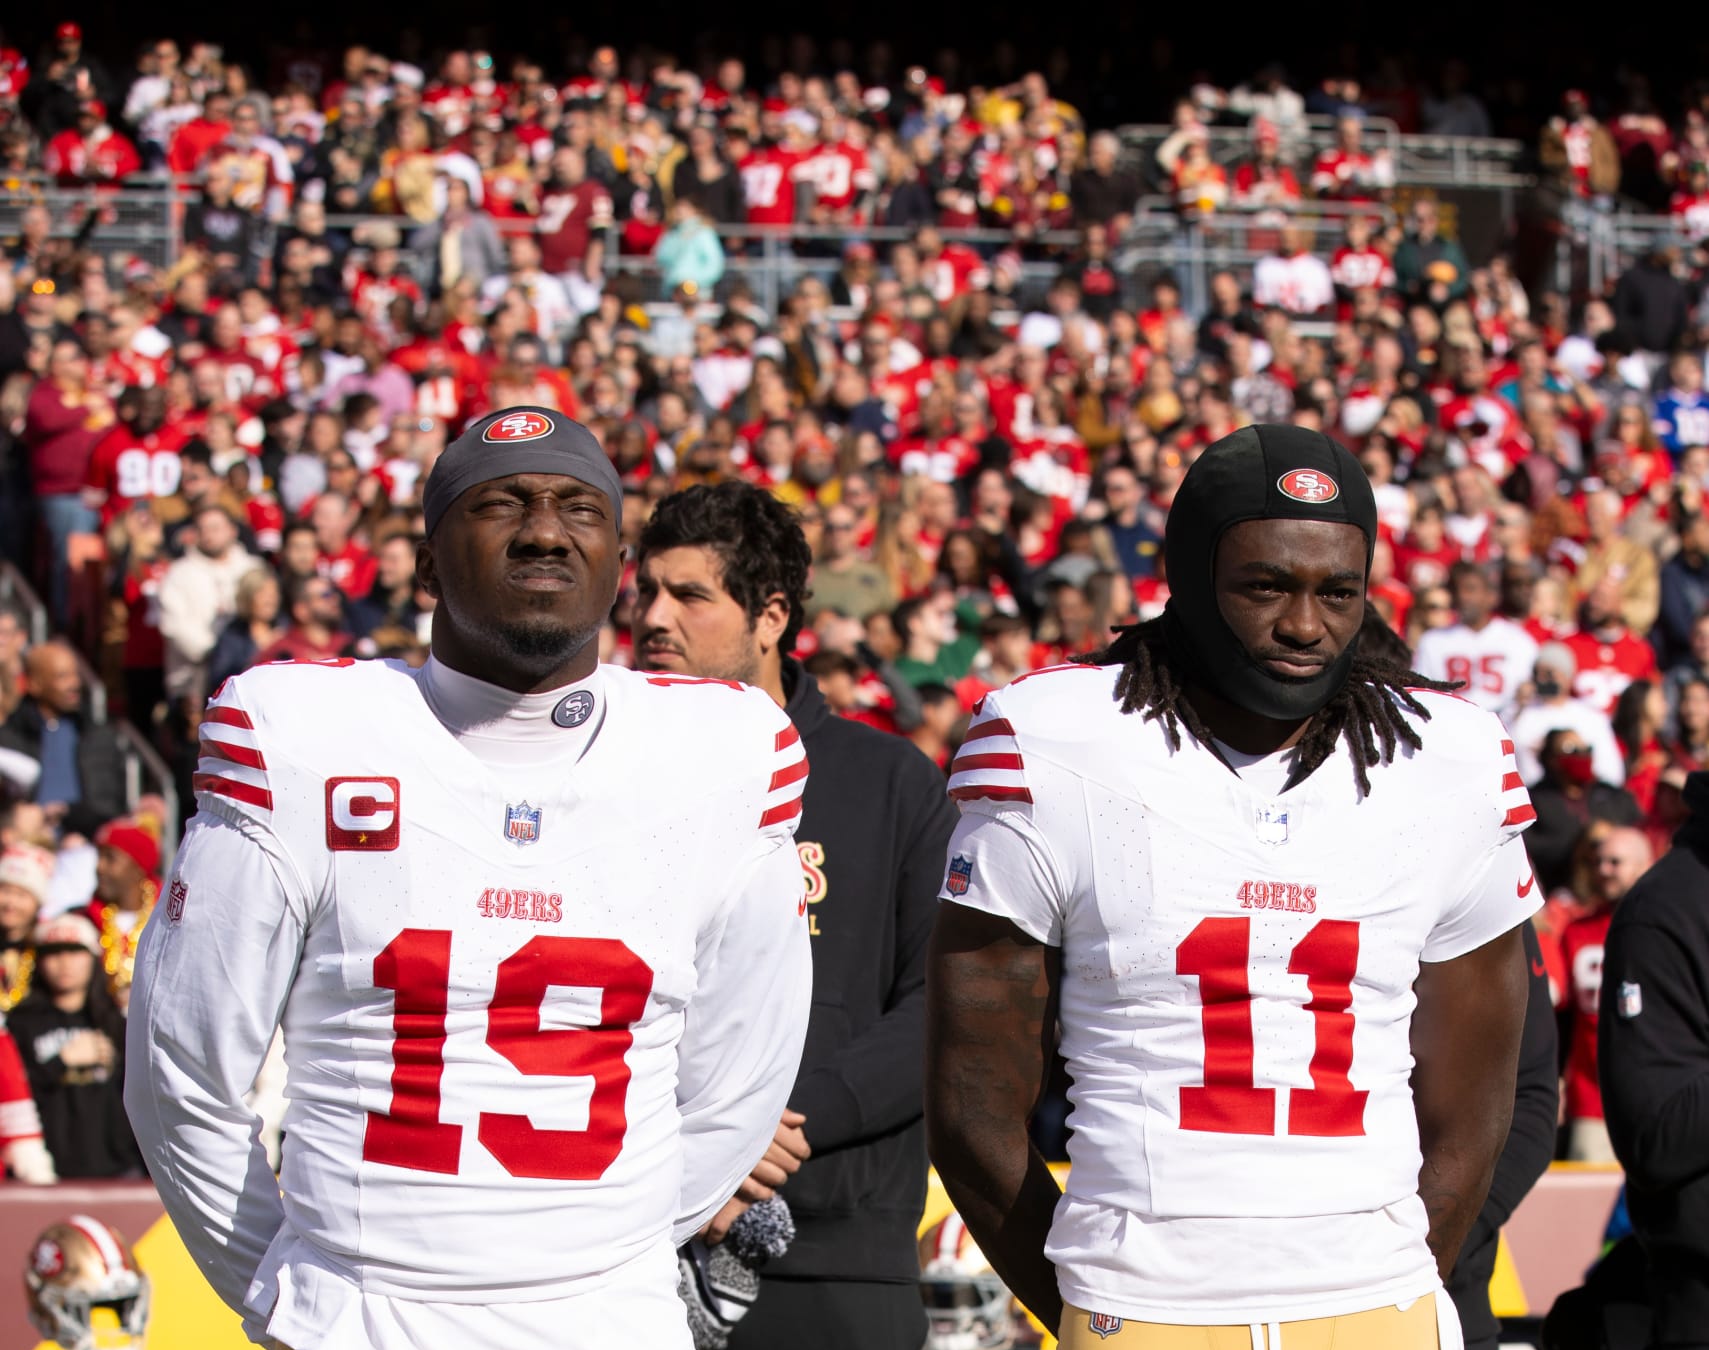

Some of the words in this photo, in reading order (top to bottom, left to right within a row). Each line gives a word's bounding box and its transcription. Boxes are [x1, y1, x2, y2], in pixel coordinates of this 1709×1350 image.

[117, 449, 181, 496] 90
[1446, 655, 1505, 694] 85
[332, 782, 395, 831] C
[510, 821, 534, 840] NFL
[476, 888, 563, 923] 49ERS
[1236, 880, 1317, 914] 49ERS
[1175, 916, 1370, 1137] 11
[363, 928, 654, 1181] 19
